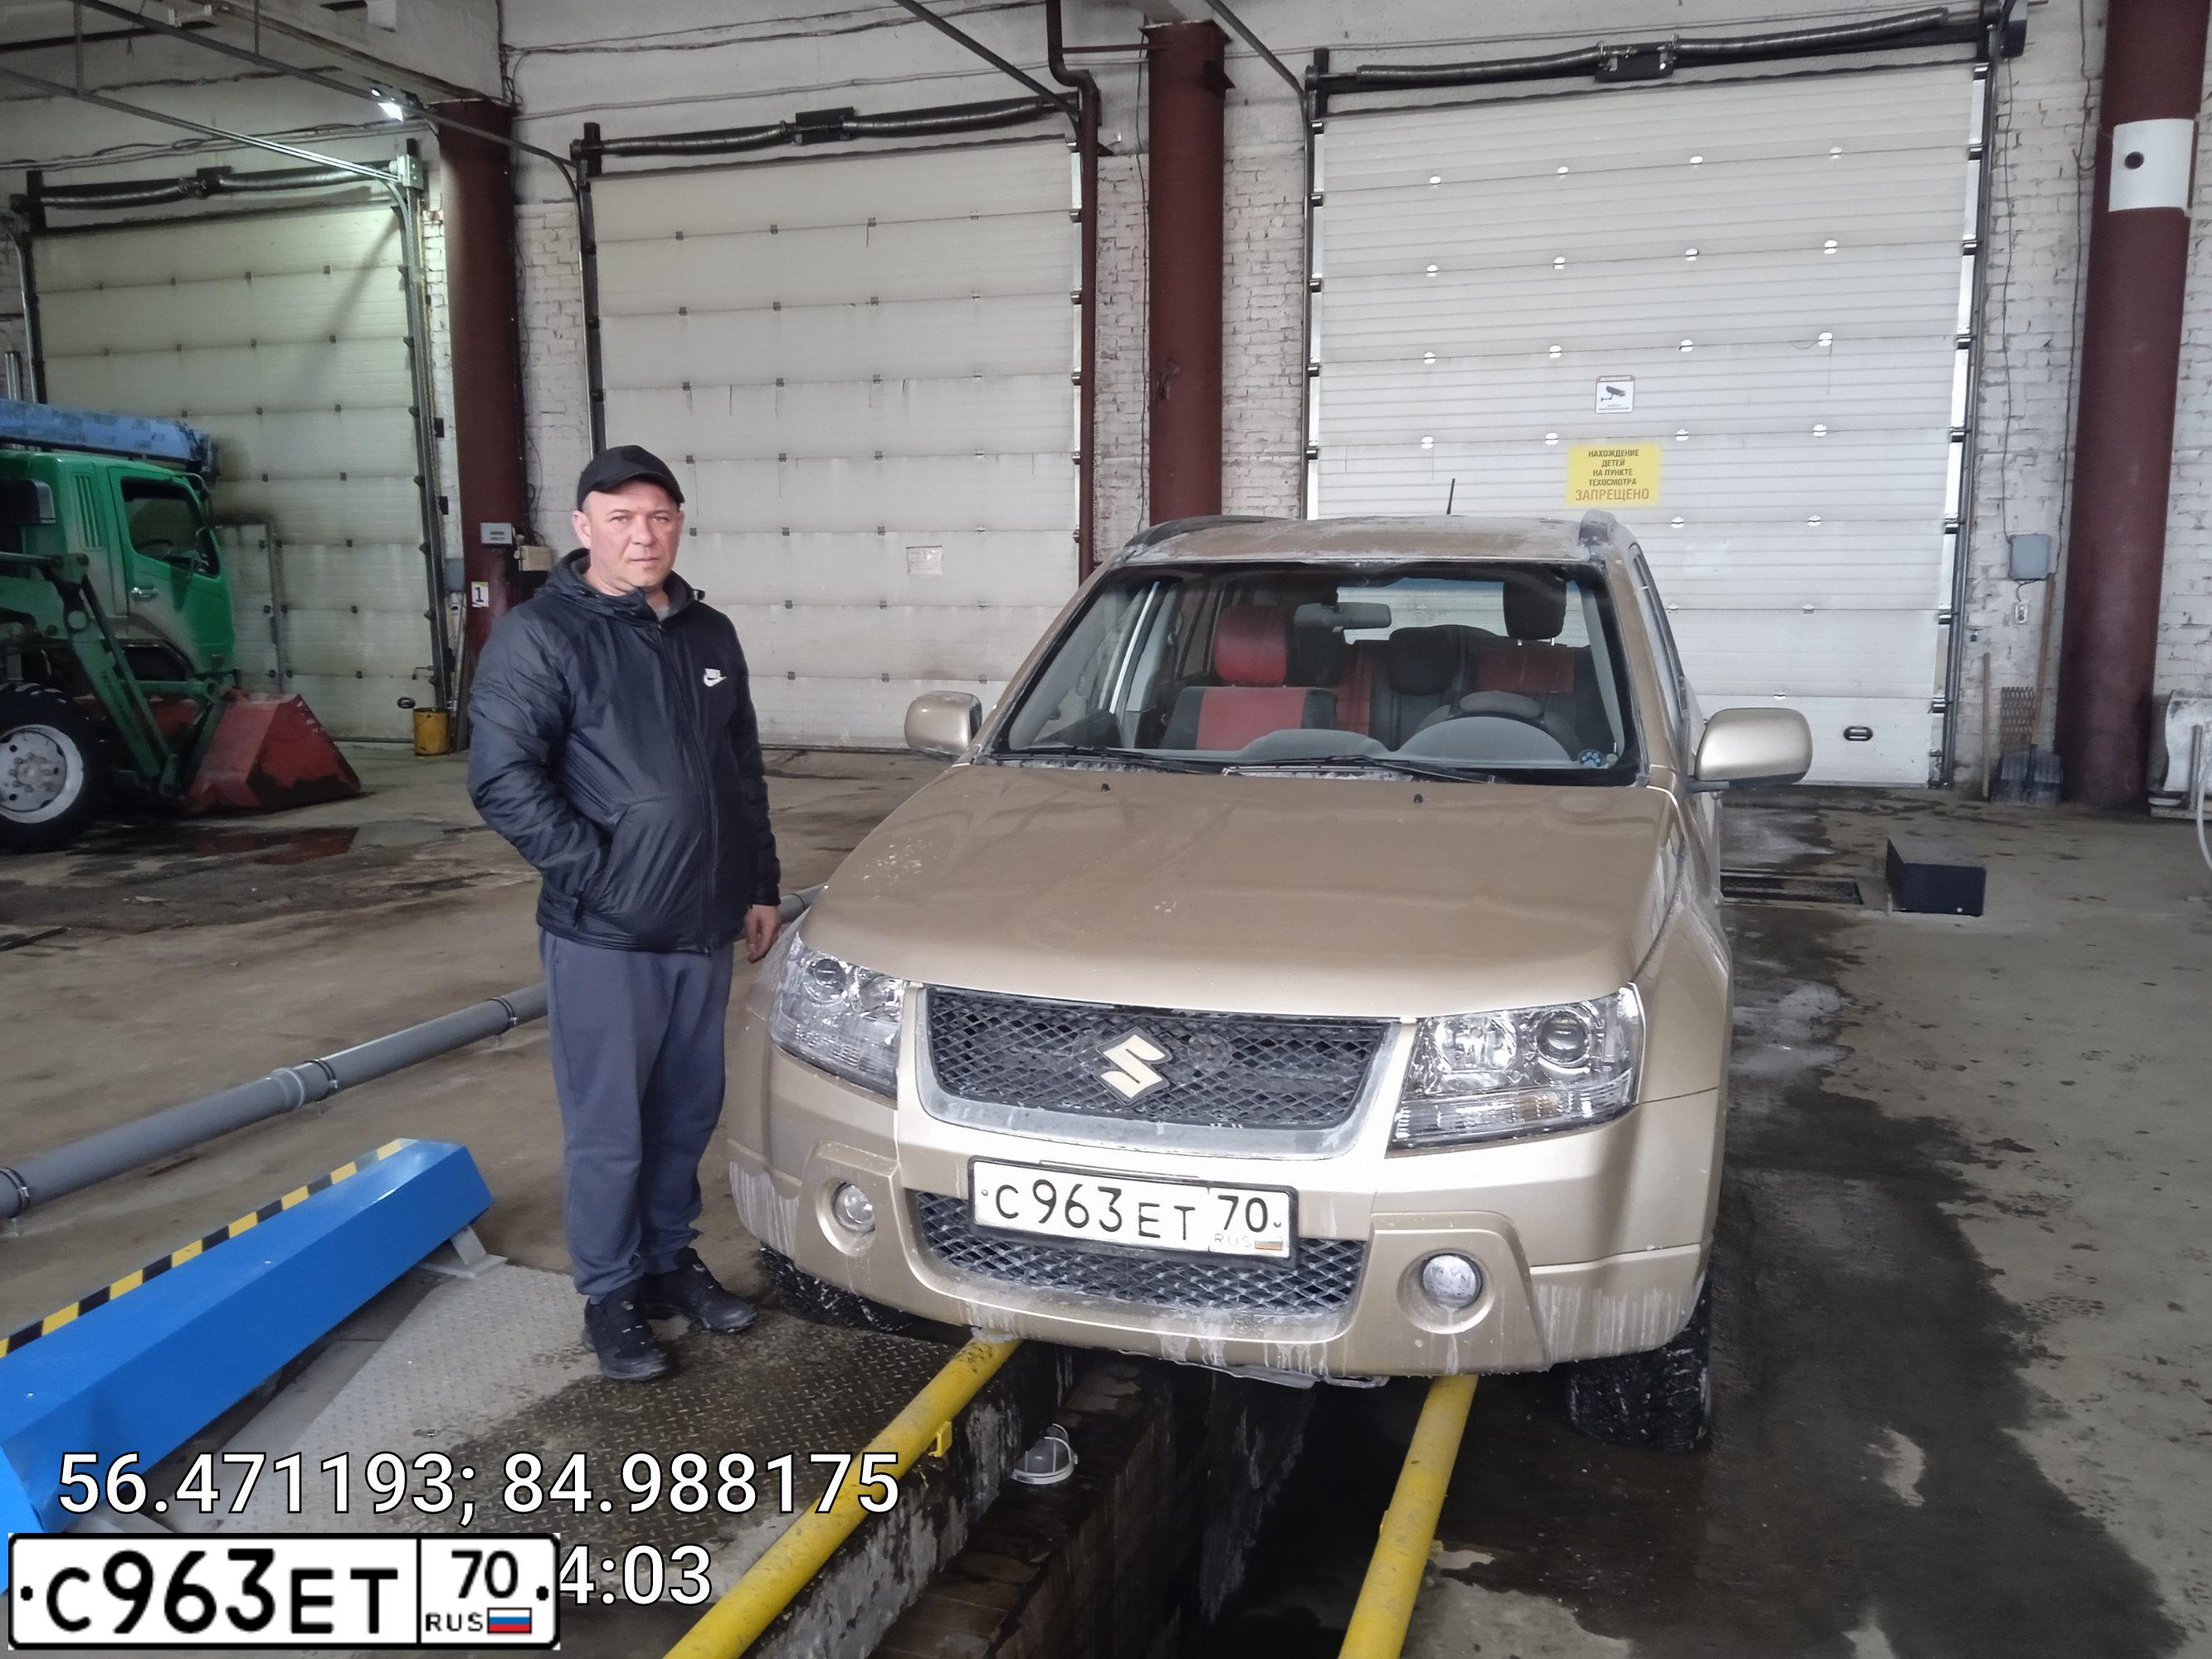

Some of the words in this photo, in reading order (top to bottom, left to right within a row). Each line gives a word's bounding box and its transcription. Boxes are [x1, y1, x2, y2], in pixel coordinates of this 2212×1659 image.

[1588, 449, 1640, 458] НАХОЖДЕНИЕ
[1601, 459, 1625, 468] ДЕТЕЙ
[1604, 468, 1633, 477] ПУНКТЕ
[1589, 478, 1637, 486] ТЕХОСМОТРА
[1575, 488, 1649, 502] ЗАПРЕЩЕНО
[475, 586, 485, 603] 1
[1217, 1194, 1269, 1233] 70
[1214, 1233, 1252, 1248] RUS
